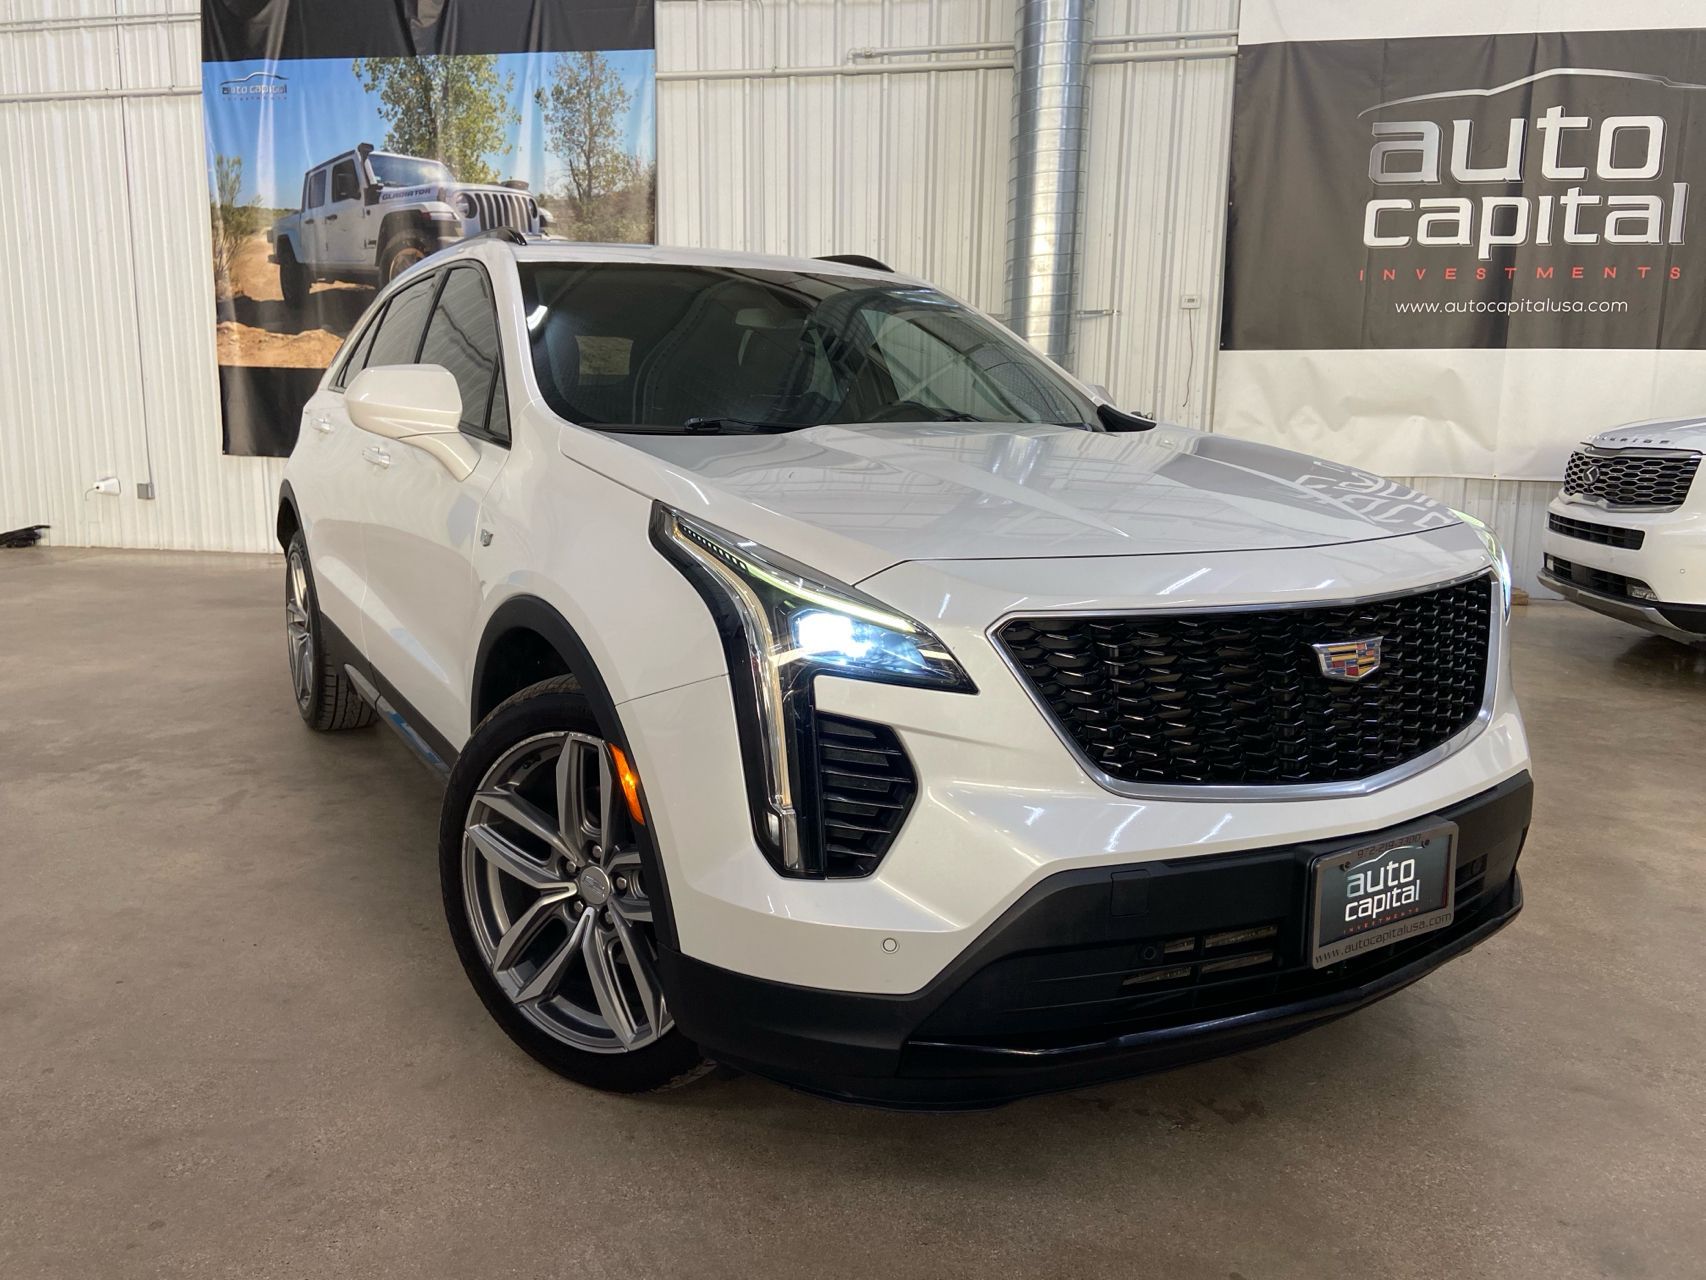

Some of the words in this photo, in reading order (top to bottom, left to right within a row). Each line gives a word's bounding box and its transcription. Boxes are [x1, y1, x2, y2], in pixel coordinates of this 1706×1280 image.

[1368, 105, 1666, 184] auto
[382, 188, 431, 199] GLADIATOR
[1363, 182, 1690, 261] capital
[1359, 266, 1681, 281] INVESTMENTS
[1395, 298, 1629, 316] www.autocapitalusa.com
[1347, 858, 1415, 898] auto
[1345, 879, 1421, 922] capital
[1315, 913, 1452, 964] www.autocapitalusa.com
